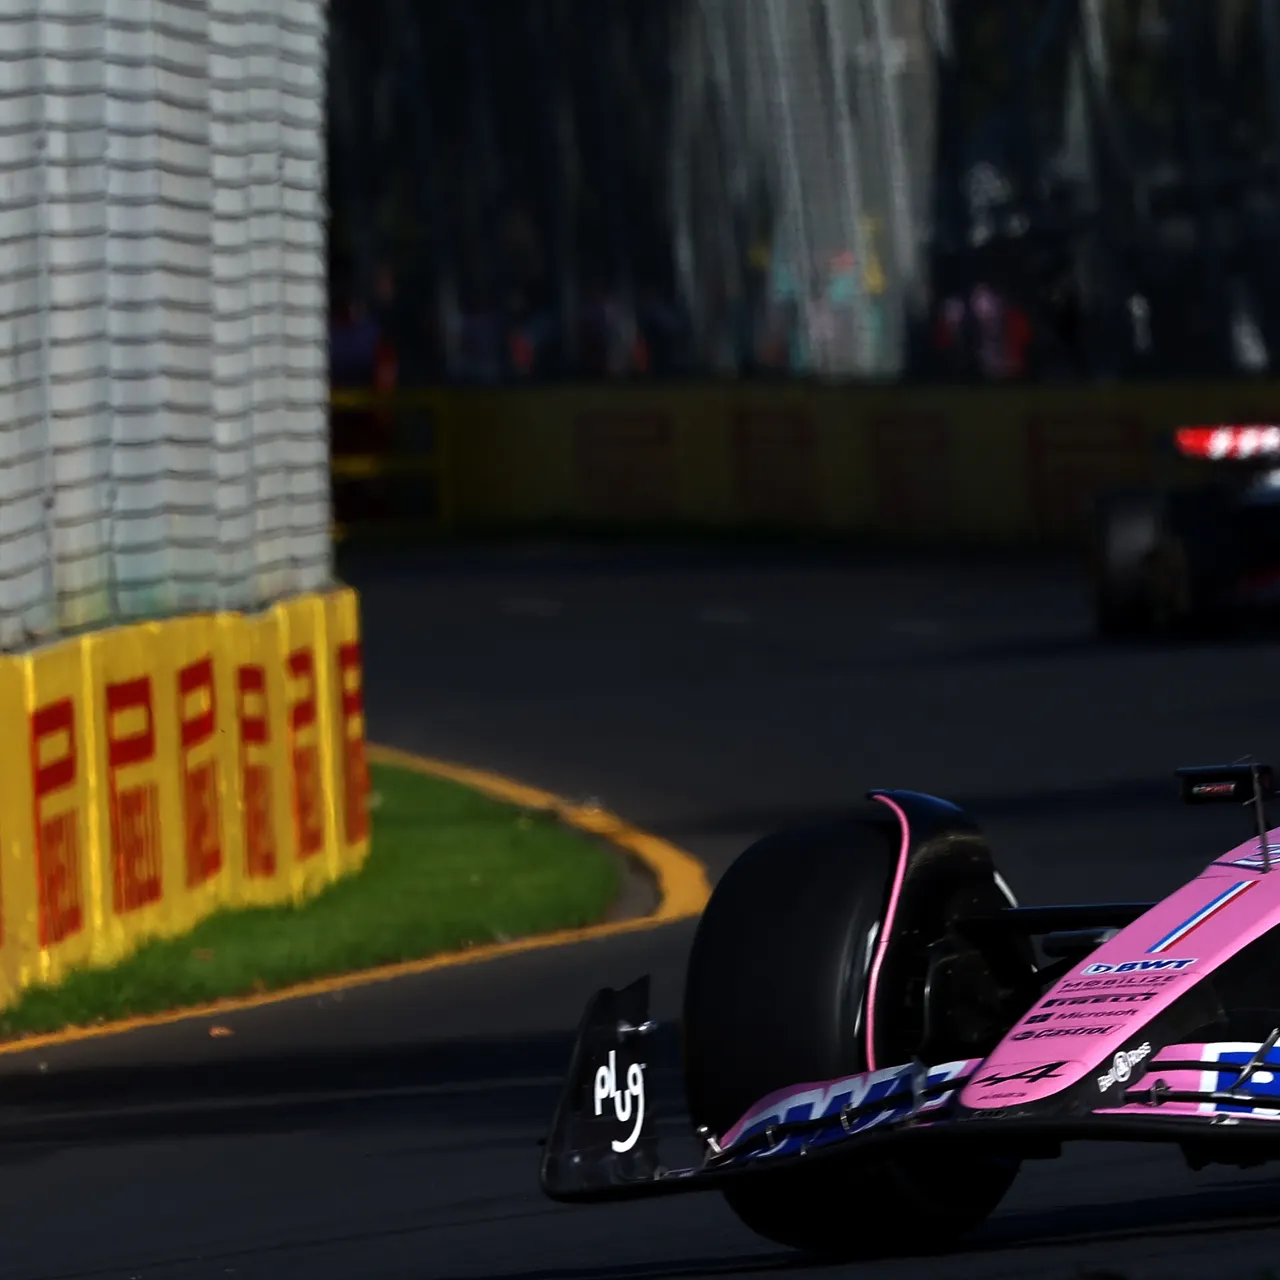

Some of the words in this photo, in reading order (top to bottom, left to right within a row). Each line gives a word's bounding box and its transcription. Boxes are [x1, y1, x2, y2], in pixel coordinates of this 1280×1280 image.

[1114, 959, 1196, 973] BWT
[1053, 1008, 1140, 1020] Microsoft
[1033, 1025, 1115, 1039] Castrol
